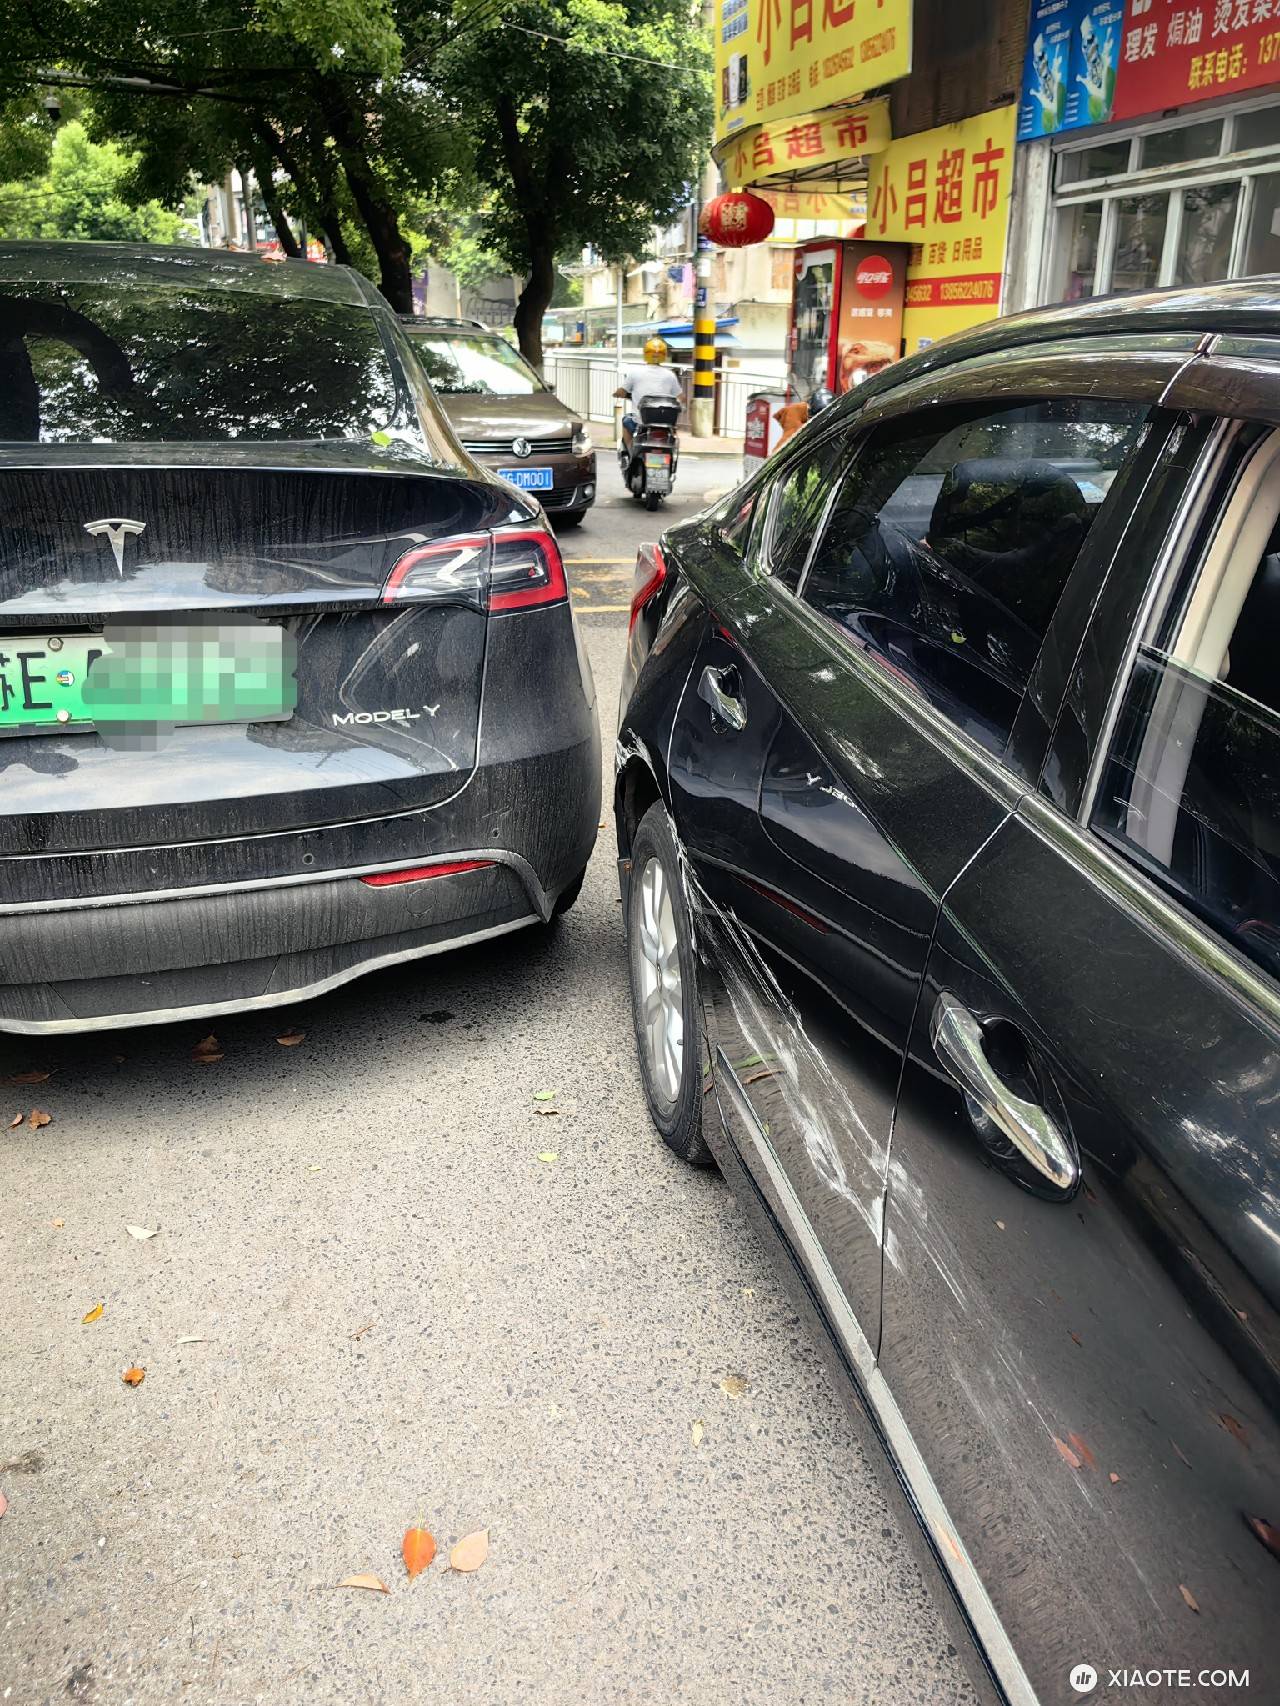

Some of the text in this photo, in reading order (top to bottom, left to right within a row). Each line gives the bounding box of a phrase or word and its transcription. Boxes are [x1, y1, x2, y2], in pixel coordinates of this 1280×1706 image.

[1257, 31, 1280, 65] 137
[734, 113, 870, 179] 小吕超市
[872, 137, 1005, 235] 小吕超市
[952, 236, 983, 263] 日用品
[331, 703, 441, 727] MODEL Y
